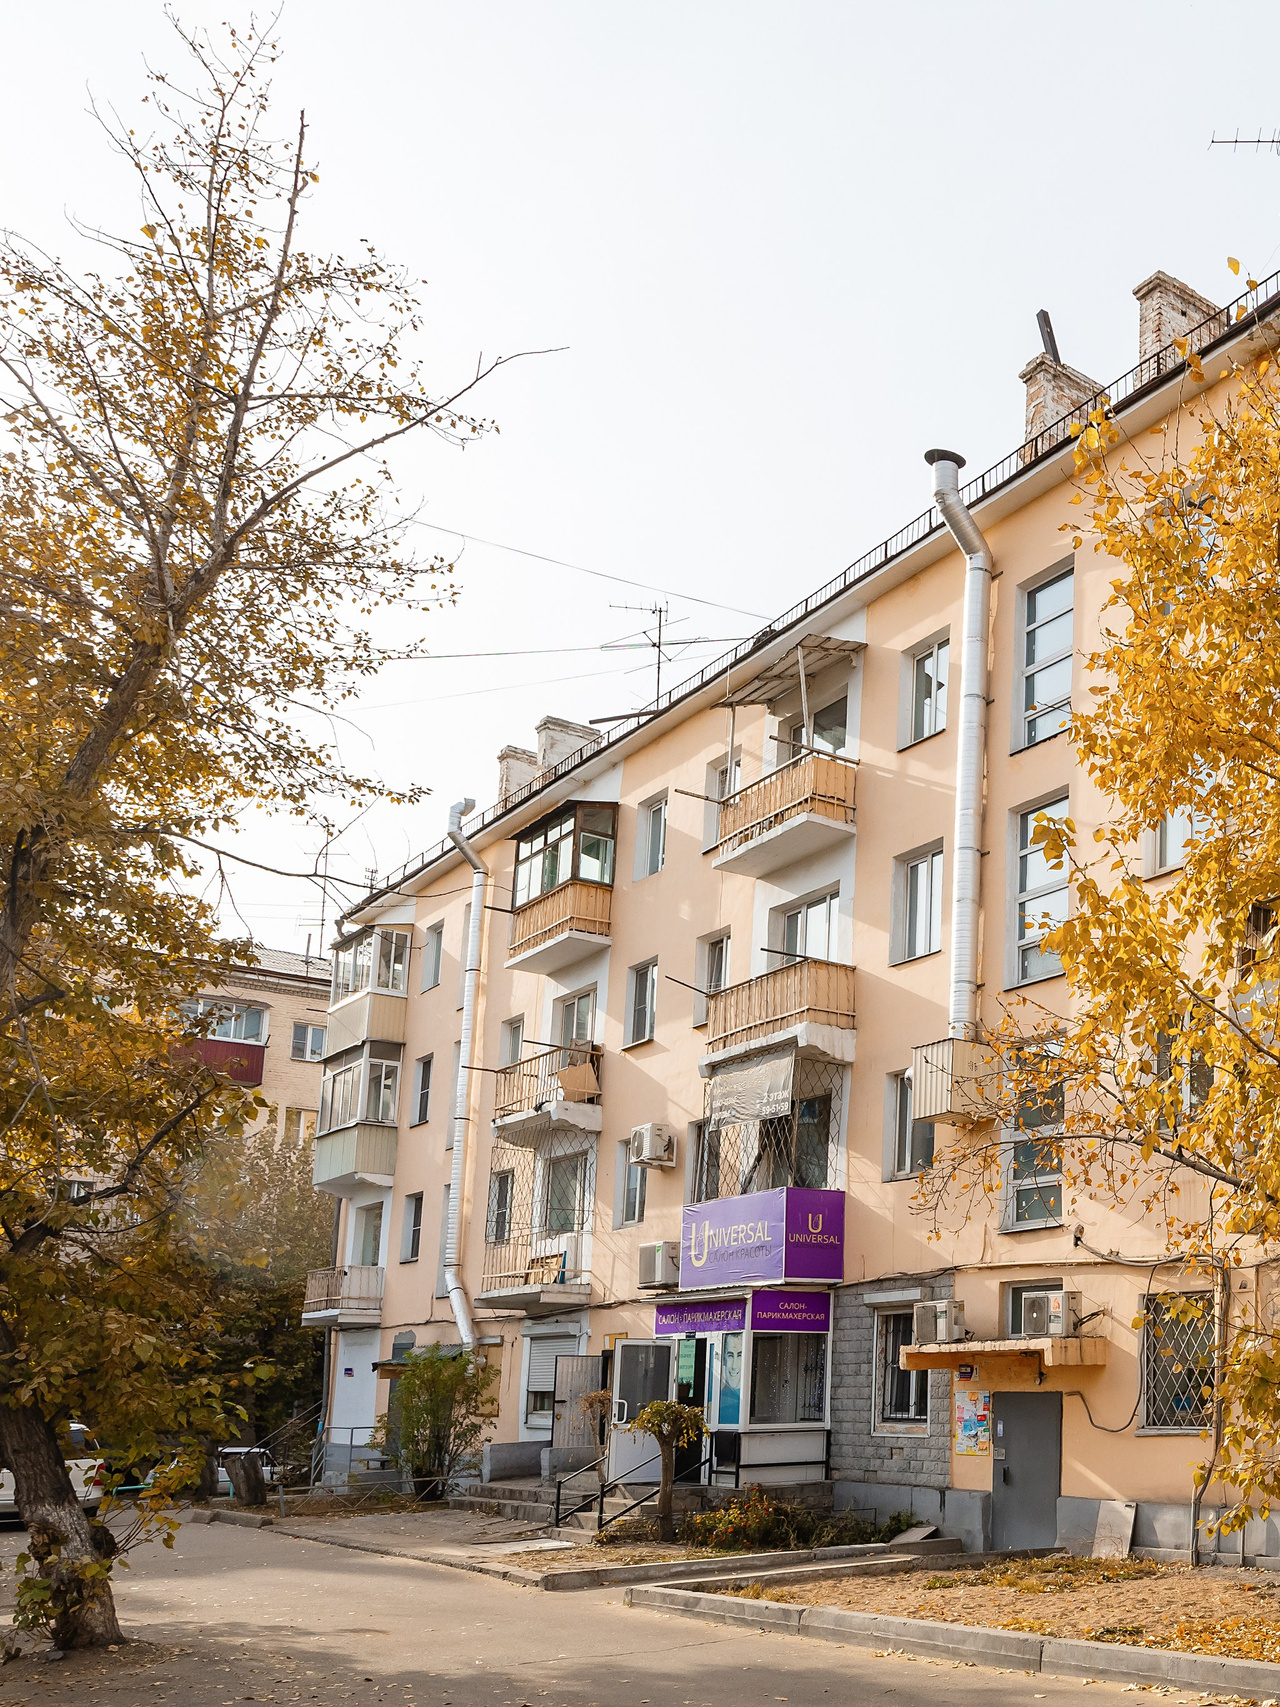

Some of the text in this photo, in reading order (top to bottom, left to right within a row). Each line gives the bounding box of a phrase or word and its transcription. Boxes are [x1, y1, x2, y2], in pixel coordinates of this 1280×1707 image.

[788, 1233, 841, 1245] UNIVERSAL
[735, 1244, 772, 1260] КРАСОТЫ
[778, 1301, 808, 1310] САЛОН-
[756, 1311, 826, 1320] ПАРИКМАХЕРСКАЯ
